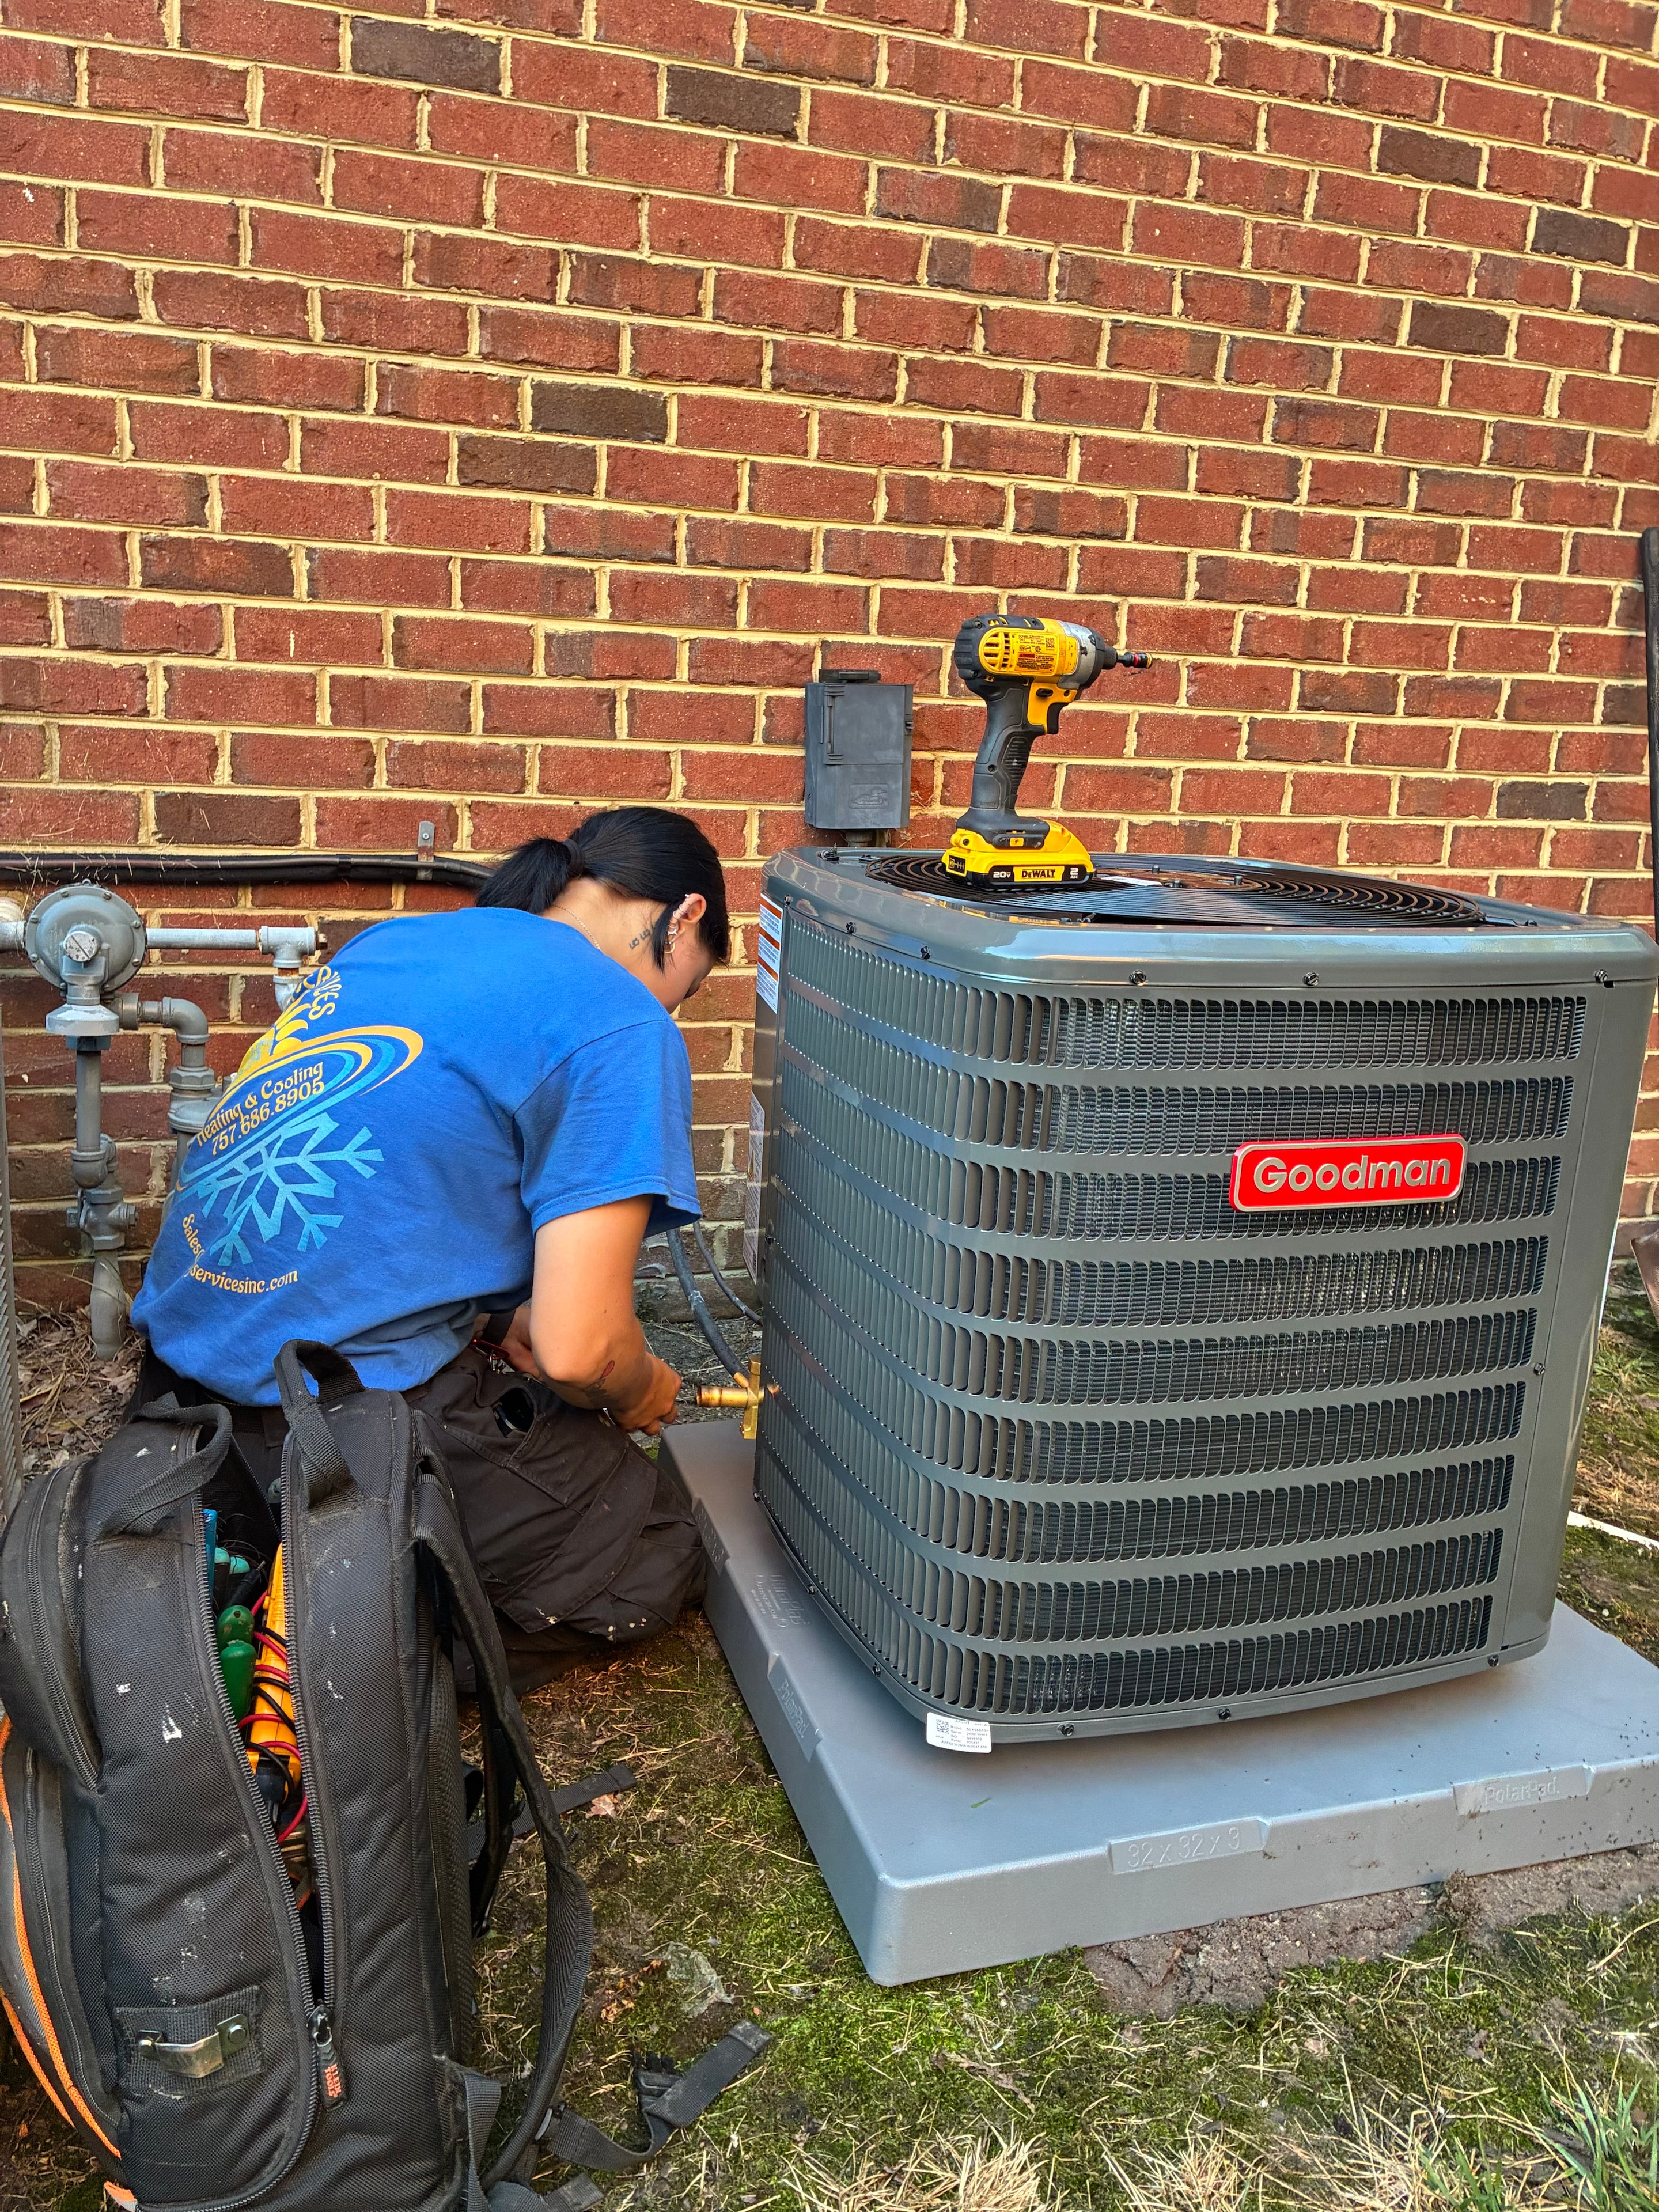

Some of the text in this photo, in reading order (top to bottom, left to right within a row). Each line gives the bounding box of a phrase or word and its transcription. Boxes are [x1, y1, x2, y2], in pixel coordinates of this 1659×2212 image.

[245, 1092, 258, 1109] &
[261, 1062, 323, 1099] Cooling
[212, 1081, 325, 1156] 757.686.8905
[1253, 1155, 1451, 1193] Goodman
[1128, 1827, 1240, 1868] 32 x 32 x 3
